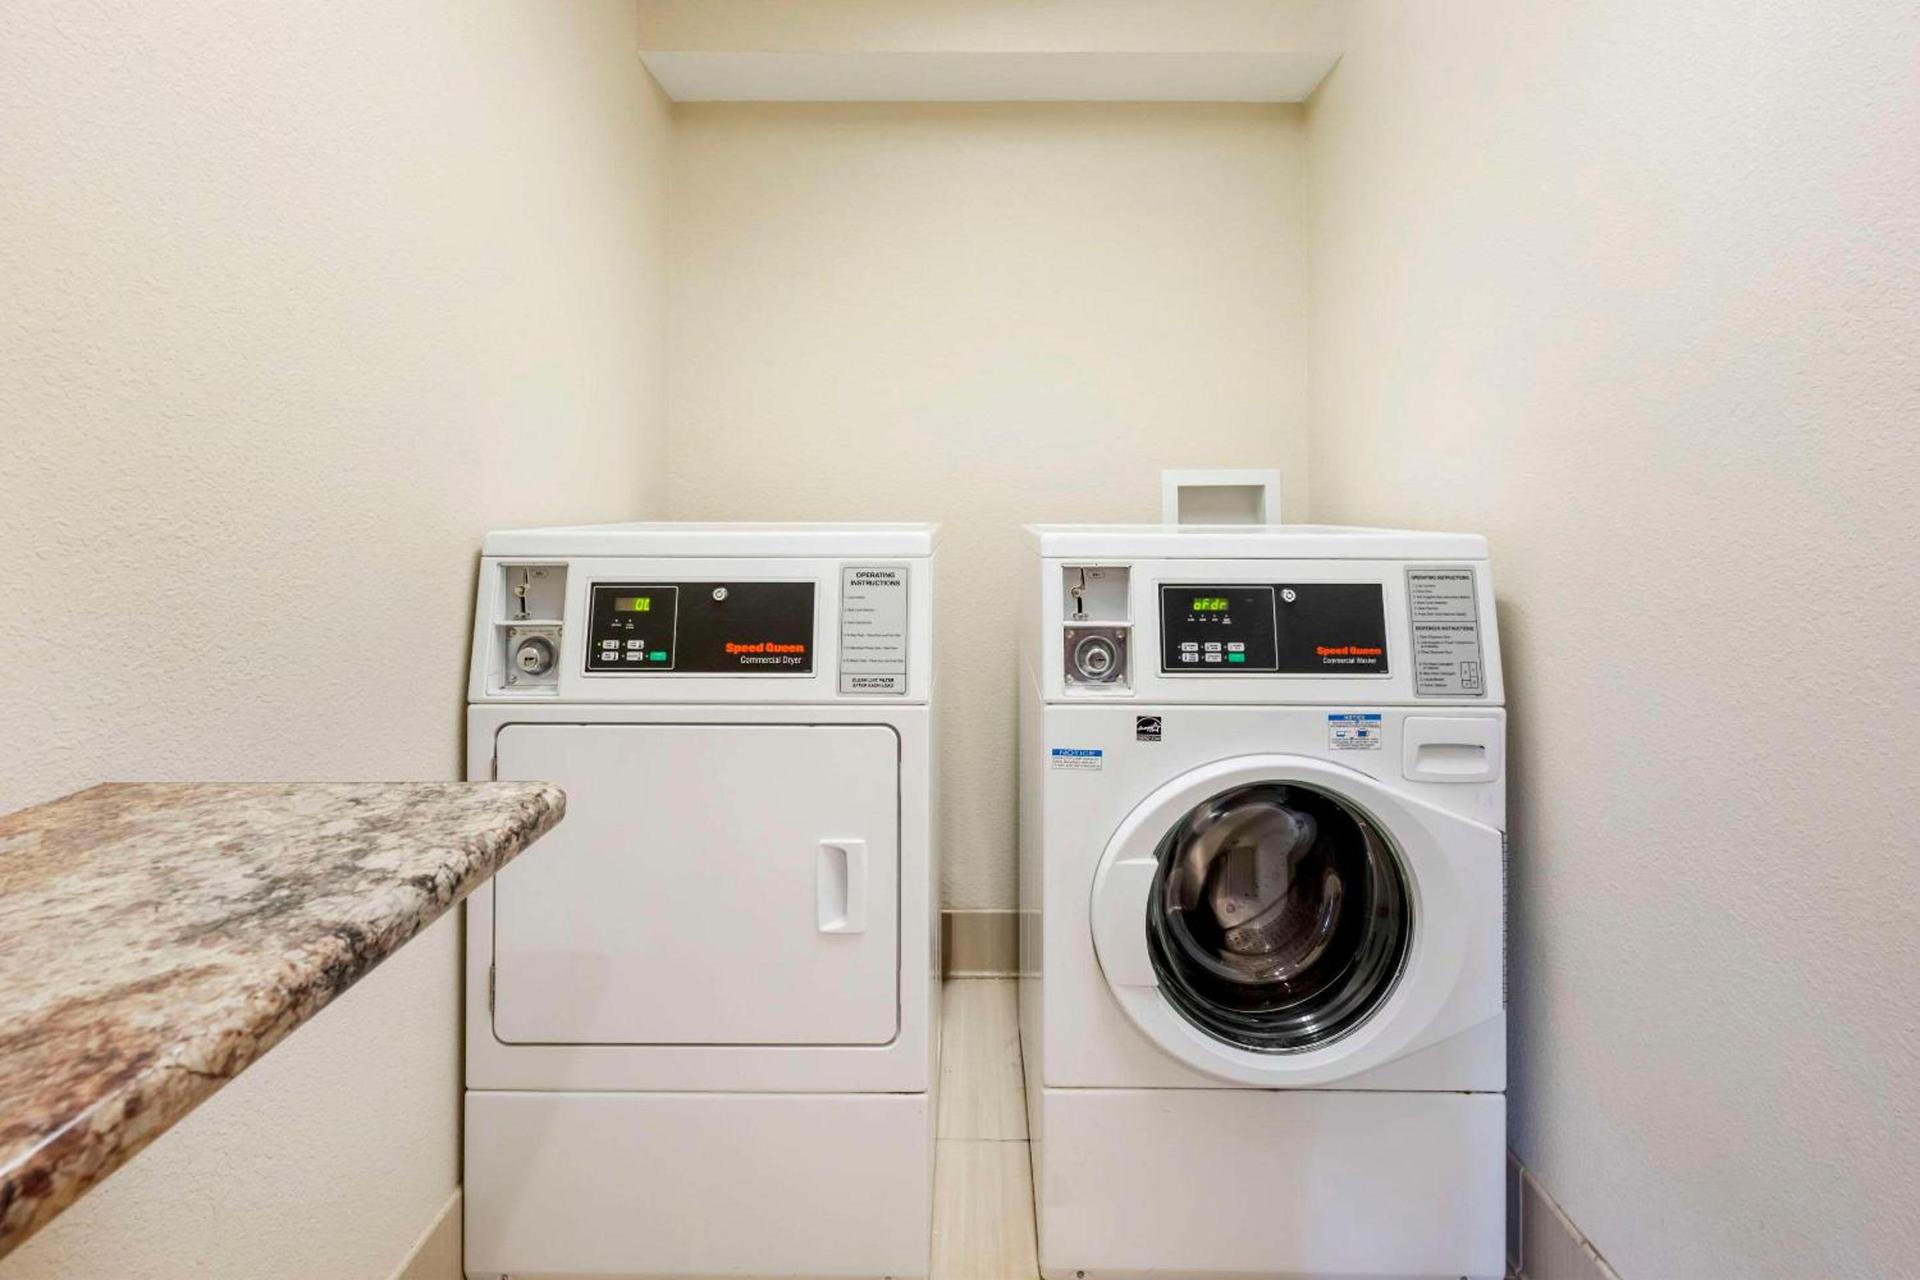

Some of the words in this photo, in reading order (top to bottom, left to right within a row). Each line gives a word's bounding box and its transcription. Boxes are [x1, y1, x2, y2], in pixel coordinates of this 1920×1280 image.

[725, 642, 764, 655] Speed
[765, 642, 805, 653] Queen
[1316, 646, 1349, 656] Speed
[1349, 646, 1382, 655] Queen
[740, 656, 781, 664] Commercial
[782, 656, 802, 666] Dryer
